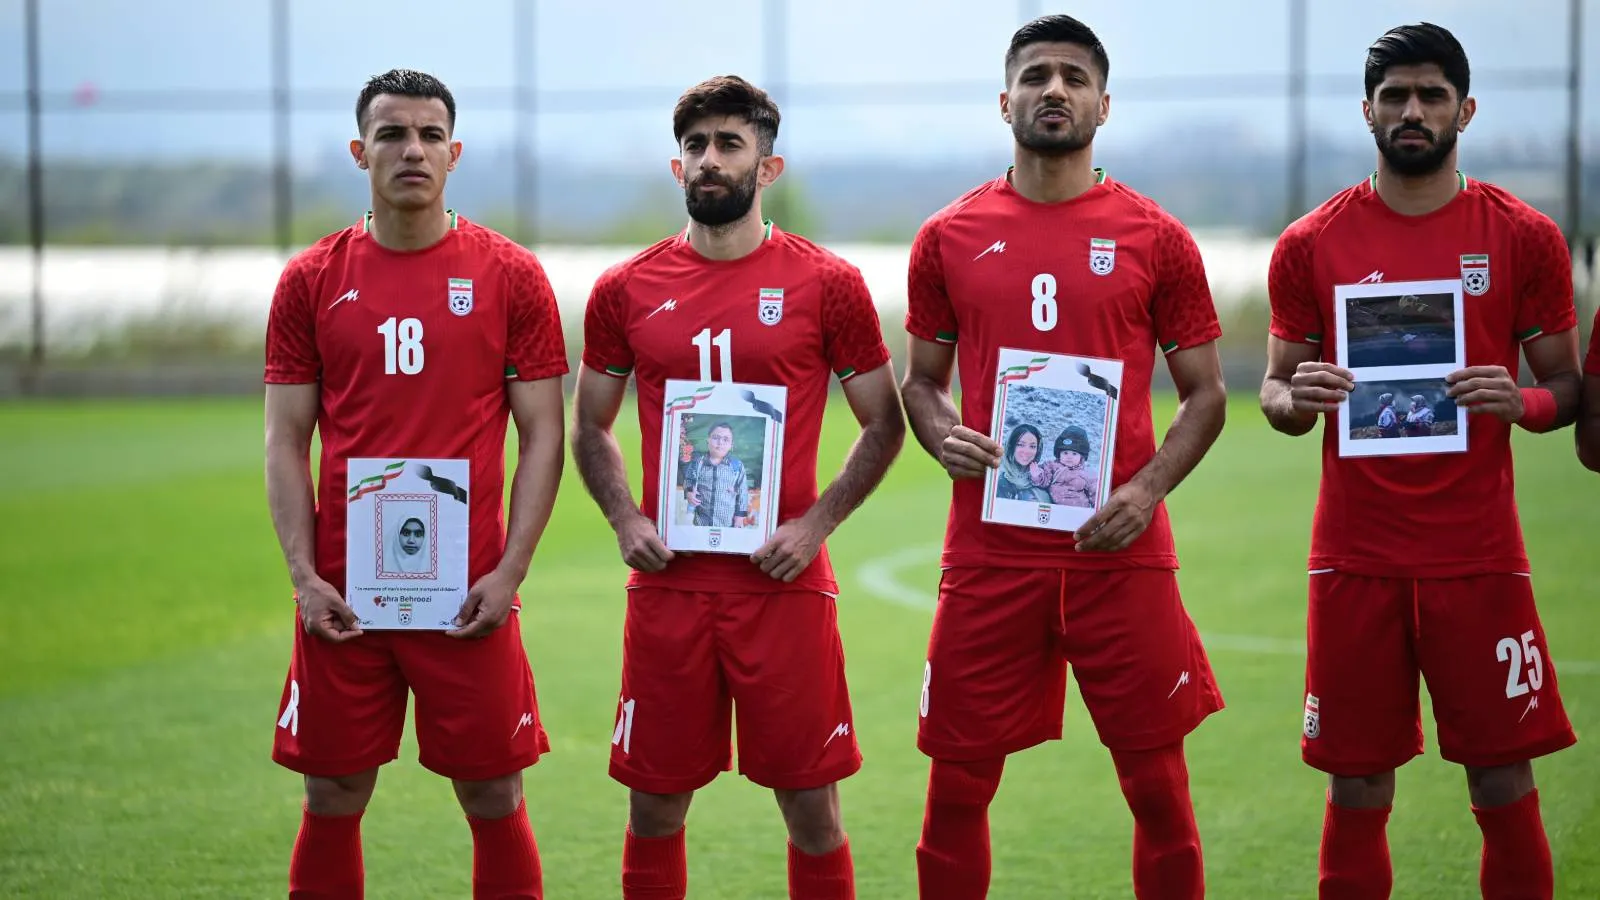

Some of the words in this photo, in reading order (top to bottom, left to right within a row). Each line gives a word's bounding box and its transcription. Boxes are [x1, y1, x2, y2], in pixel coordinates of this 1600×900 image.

[1031, 273, 1058, 332] 8
[377, 316, 425, 375] 18
[691, 327, 733, 384] 11
[400, 595, 432, 603] Behroozi
[1496, 629, 1543, 699] 25
